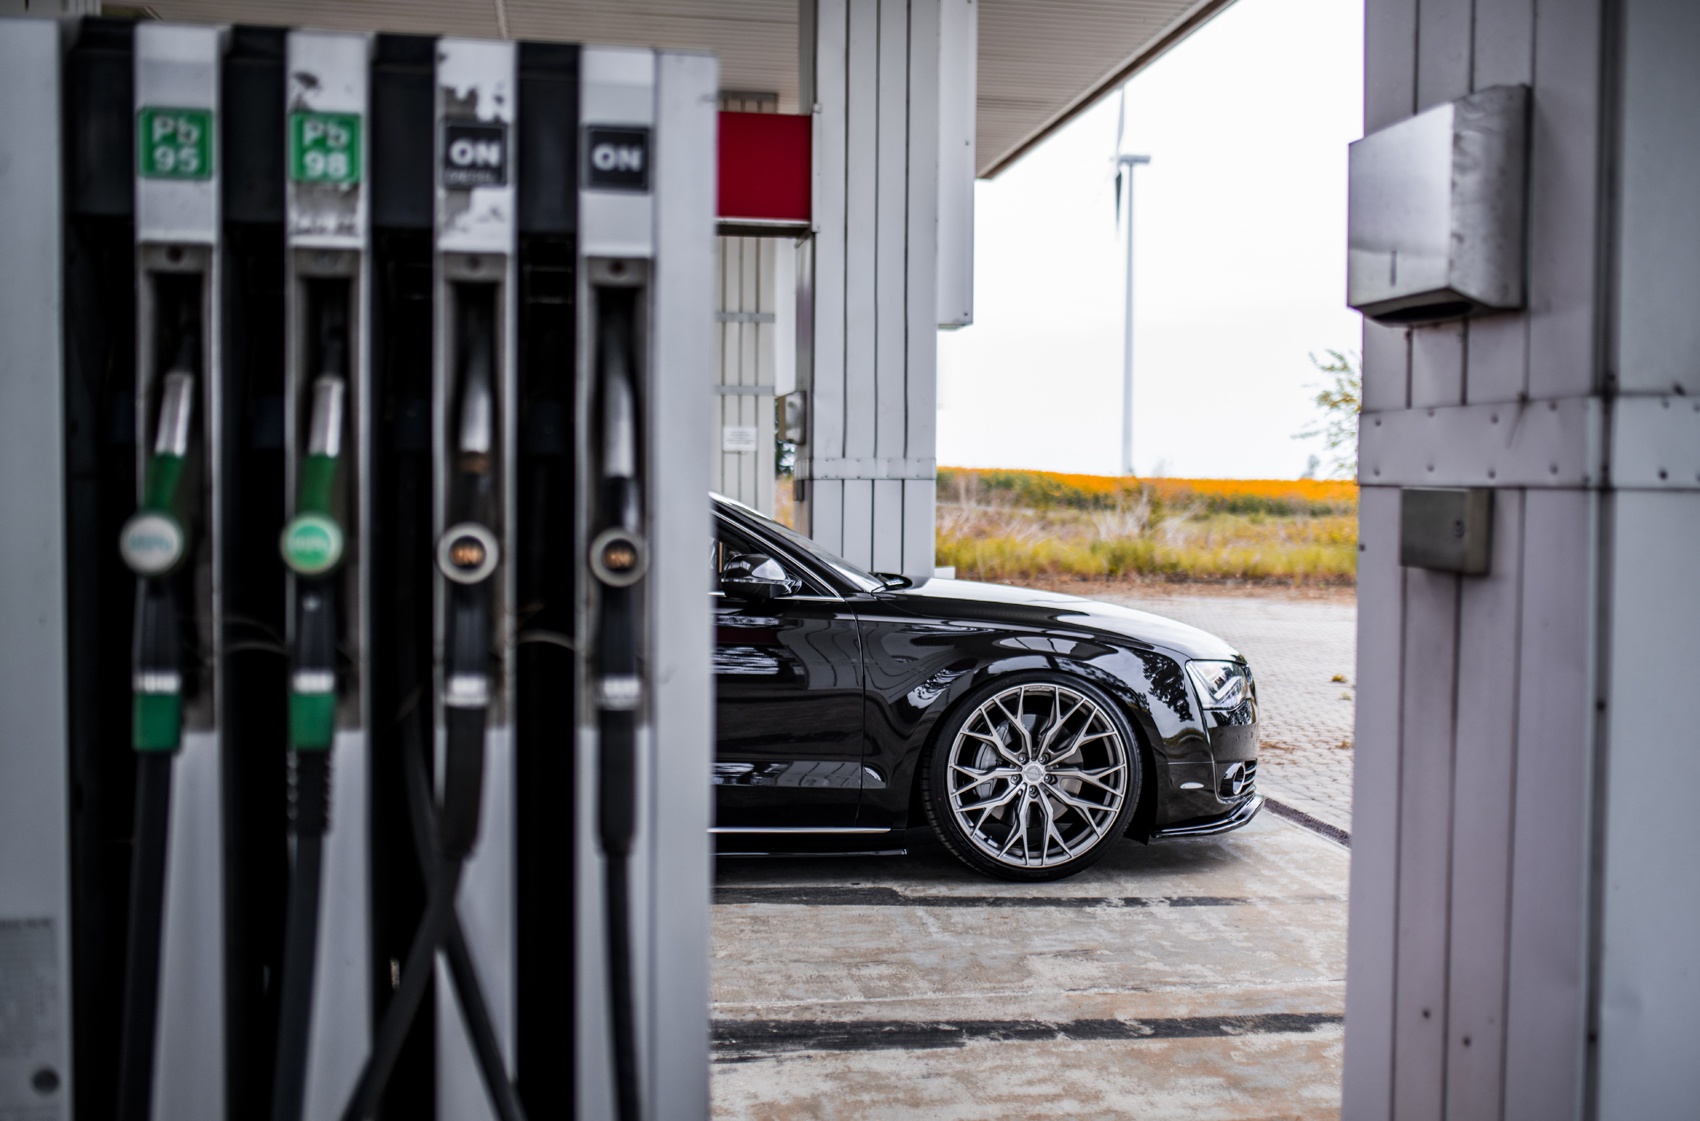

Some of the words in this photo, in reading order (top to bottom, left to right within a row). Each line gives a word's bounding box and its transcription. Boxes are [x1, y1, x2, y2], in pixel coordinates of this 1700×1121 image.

[154, 116, 200, 143] Pb
[304, 120, 350, 148] Pb
[154, 146, 199, 173] 95
[304, 151, 350, 178] 98
[450, 139, 500, 168] ON
[592, 143, 641, 172] ON
